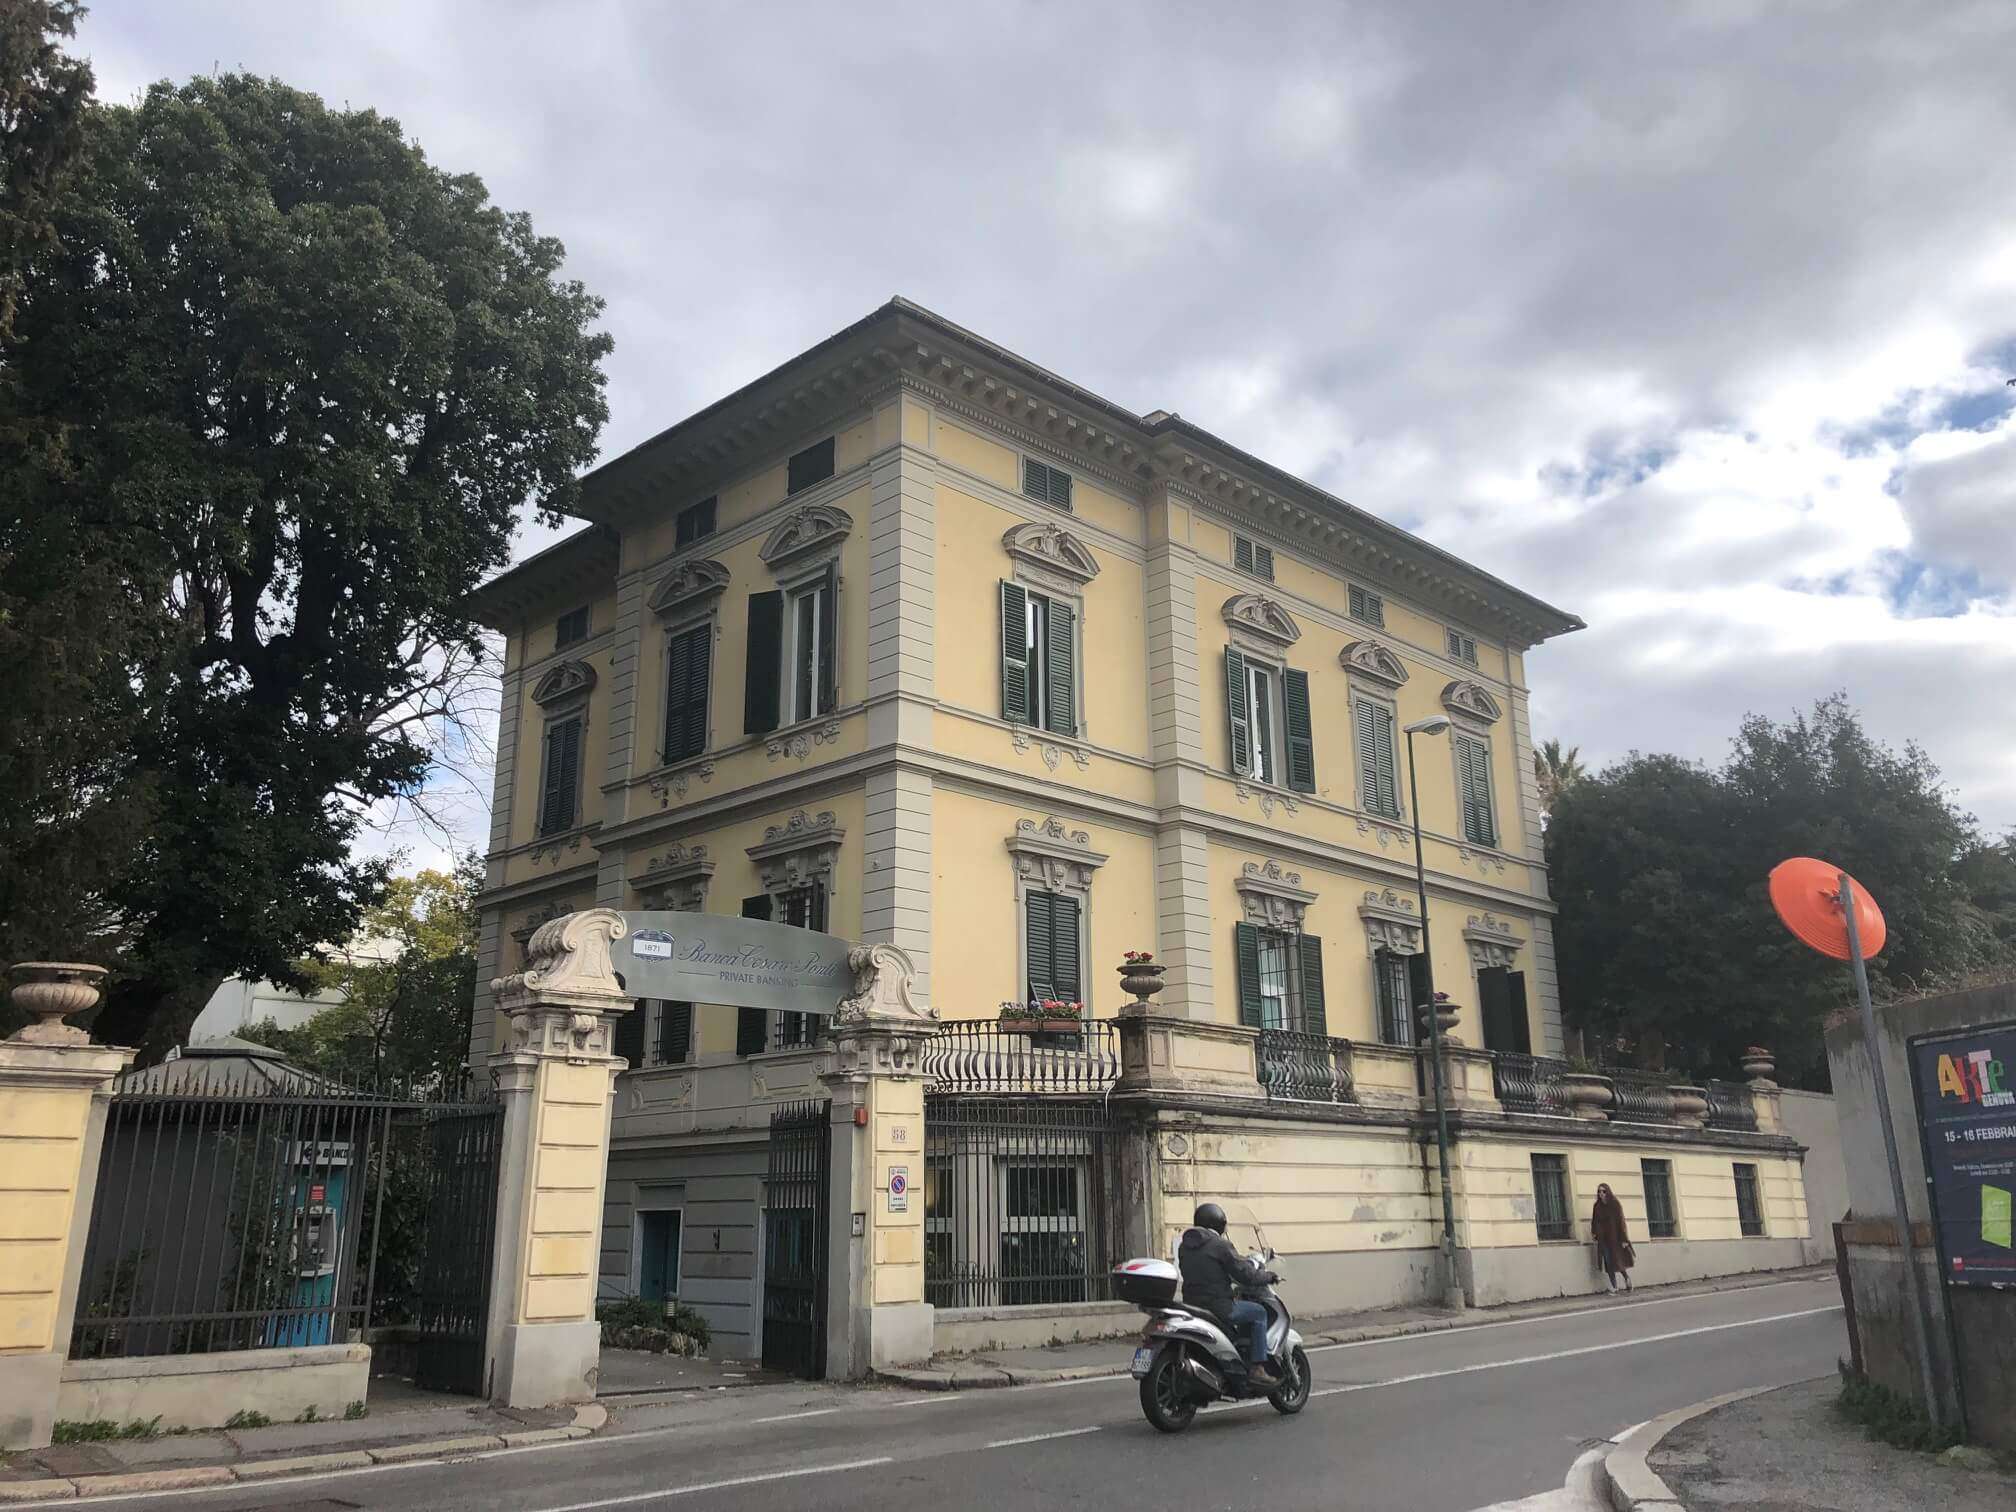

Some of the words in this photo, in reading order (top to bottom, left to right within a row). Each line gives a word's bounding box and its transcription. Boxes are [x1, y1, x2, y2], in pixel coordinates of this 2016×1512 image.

[644, 943, 661, 953] 1871
[678, 938, 737, 966] Banca
[719, 971, 755, 985] PRIVATE
[1981, 1091, 2015, 1107] GENOVA
[1944, 1130, 1956, 1142] 15
